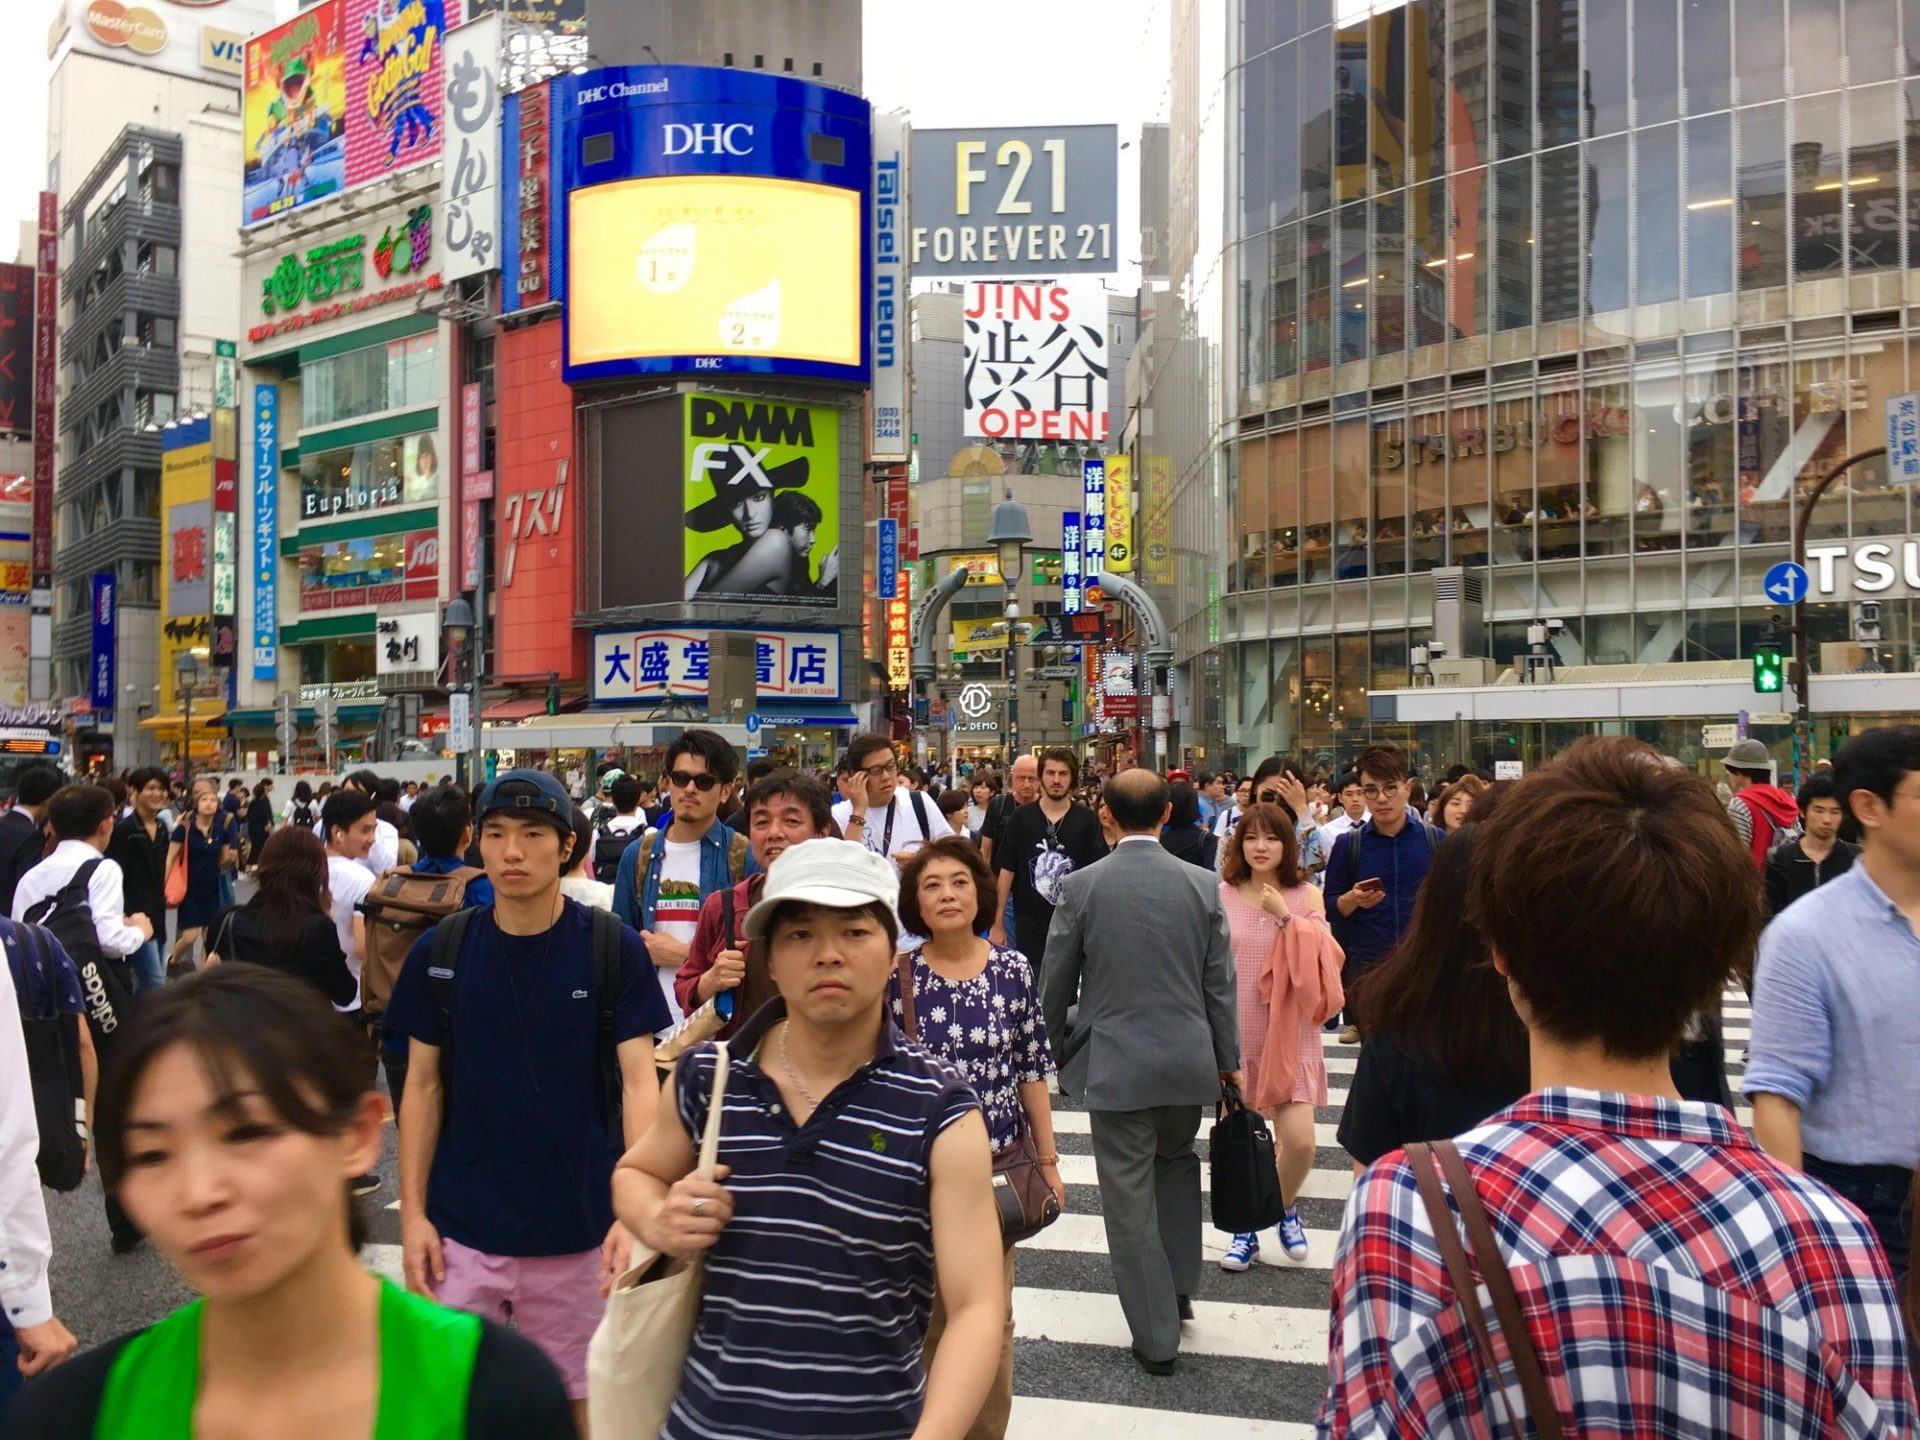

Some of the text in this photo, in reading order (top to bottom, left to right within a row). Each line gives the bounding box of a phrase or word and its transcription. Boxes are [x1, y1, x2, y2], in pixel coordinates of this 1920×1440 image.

[87, 10, 166, 41] MasterCard
[577, 77, 669, 106] DHC Channel
[662, 122, 754, 156] DHC
[955, 138, 1067, 216] F21
[877, 150, 900, 369] Taisei neon
[911, 223, 1112, 264] FOREVER 21
[695, 357, 722, 369] DHC
[963, 319, 1109, 413] 渋谷
[690, 396, 816, 448] DMM
[978, 408, 1109, 441] OPEN!
[690, 442, 774, 489] FX
[305, 481, 399, 517] Euphoria
[502, 456, 570, 588] クスリ
[1086, 465, 1104, 577] 洋服の青山
[408, 539, 438, 571] JTB
[1064, 525, 1080, 614] 洋服の青
[1110, 546, 1127, 559] 4F
[761, 717, 805, 725] TAISEIDO
[969, 721, 999, 731] DEMO
[82, 961, 118, 1034] adidas
